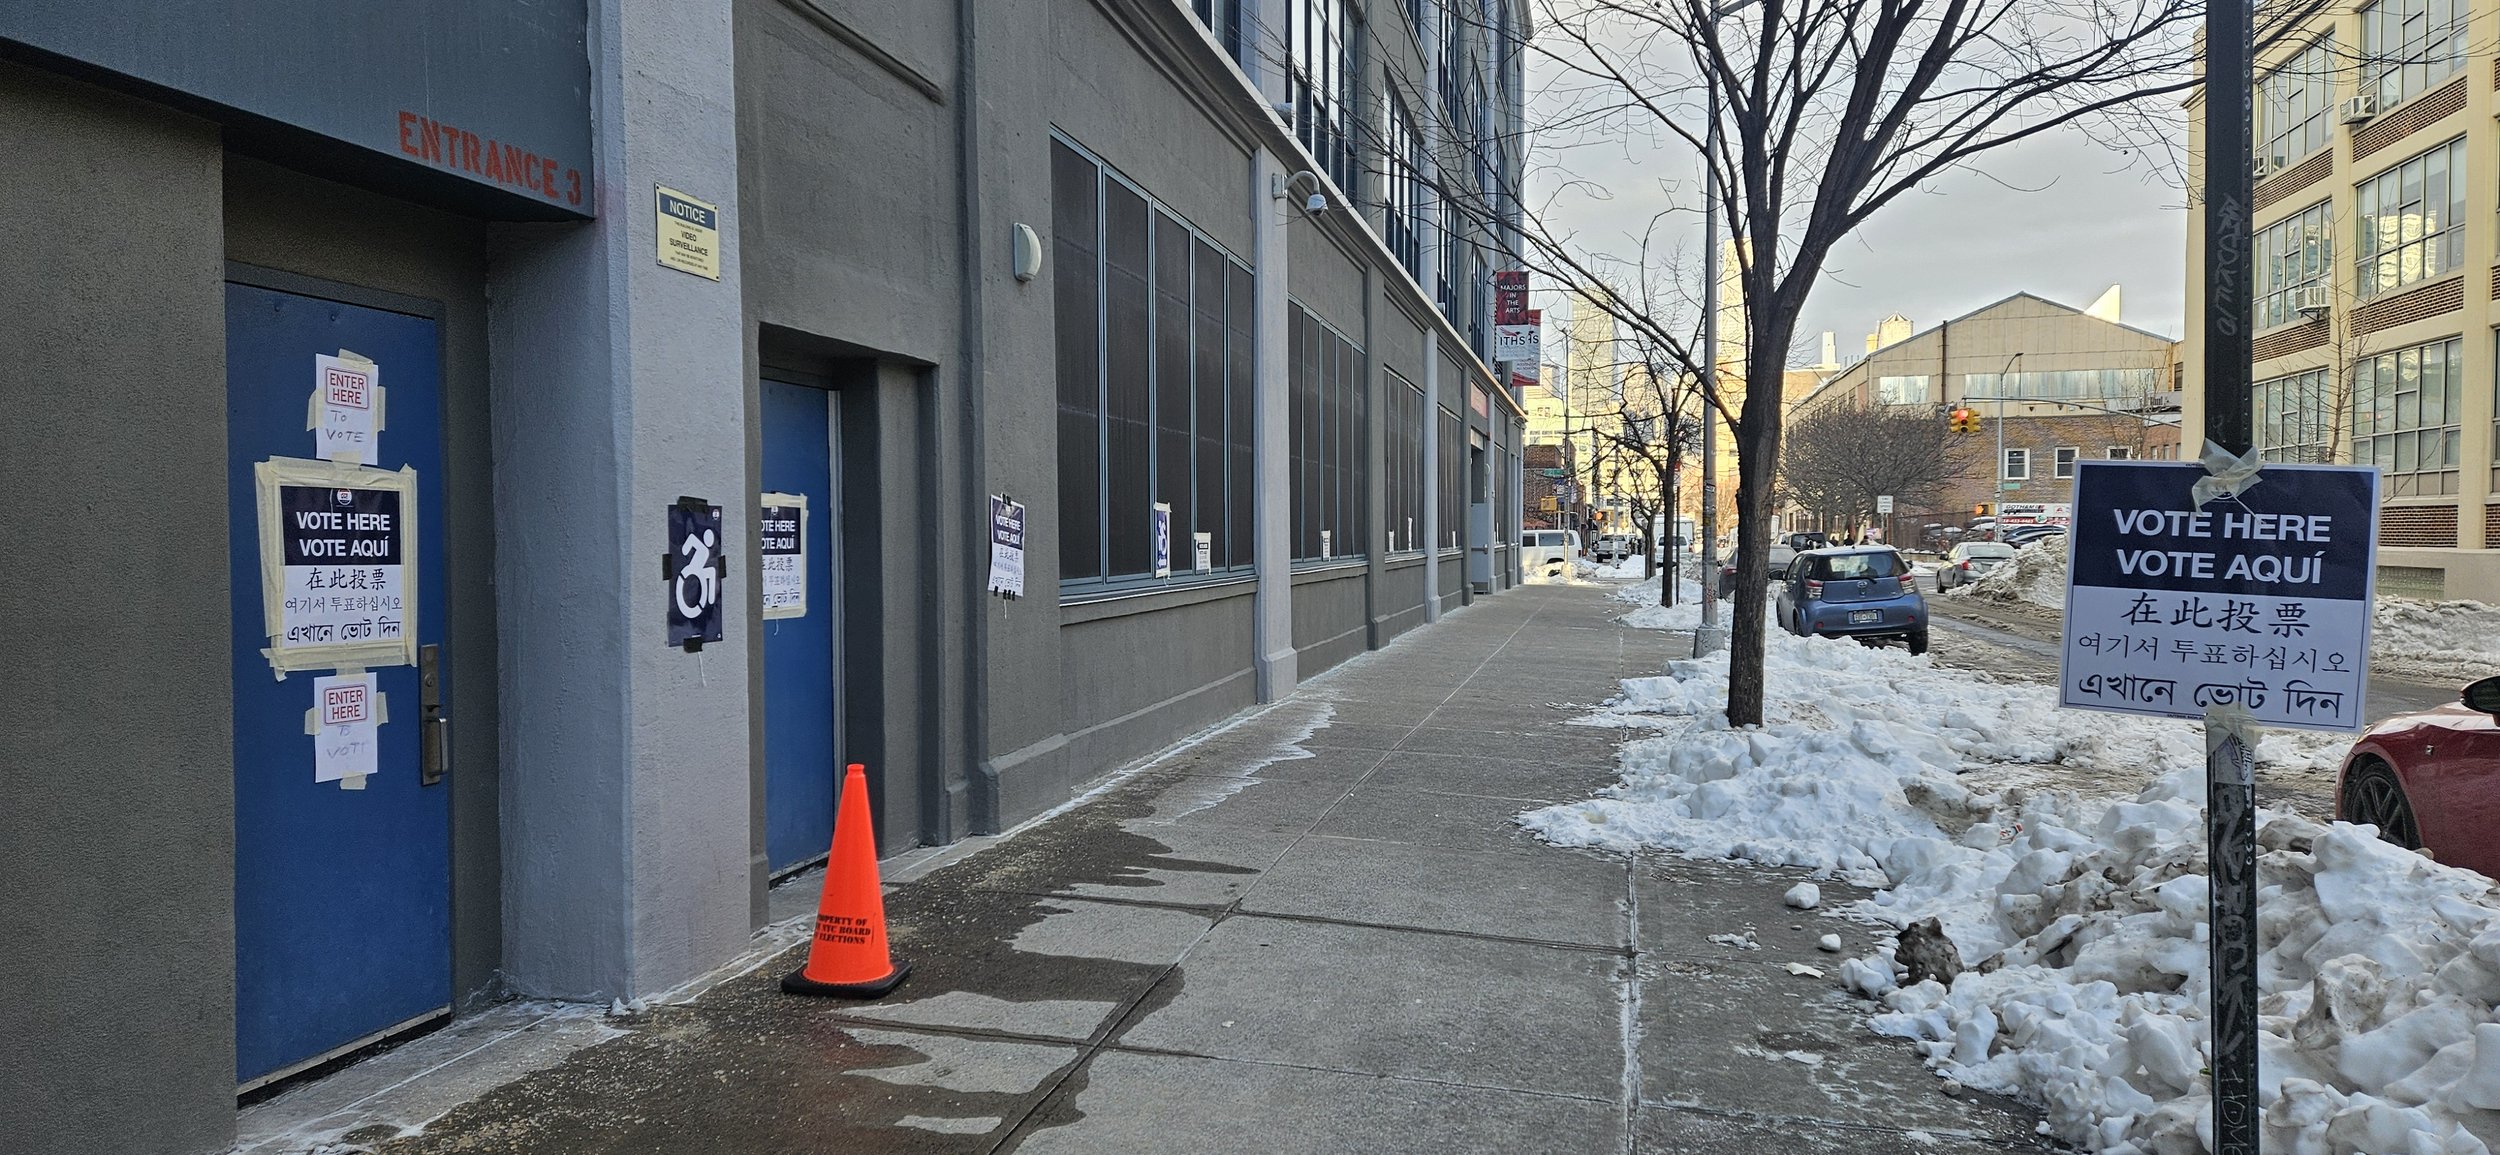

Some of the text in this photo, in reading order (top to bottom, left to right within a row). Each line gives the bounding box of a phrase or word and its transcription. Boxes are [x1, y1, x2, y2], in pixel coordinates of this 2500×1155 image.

[398, 111, 582, 207] ENTRANCE 3
[669, 200, 705, 224] NOTICE
[680, 230, 697, 242] VIDEO
[669, 238, 708, 256] SURVEILLANCE
[1500, 336, 1526, 346] ITHS
[329, 373, 365, 390] ENTER
[332, 388, 362, 405] HERE
[296, 511, 391, 531] VOTE HERE
[775, 520, 796, 532] HERE
[995, 514, 1009, 527] VOTE
[2113, 509, 2332, 542] VOTE HERE
[776, 535, 795, 549] AQUÍ
[997, 529, 1010, 542] VOTE
[299, 536, 390, 558] VOTE AQUÍ
[2116, 549, 2326, 584] VOTE AQUÍ
[305, 567, 387, 591] 在此投票
[285, 595, 403, 613] 여기서 투표하십시오
[2121, 591, 2311, 639] 在此投票
[287, 615, 401, 643] এখানে ভোট দিন
[2078, 632, 2351, 674] 여기서 투표하십시오
[328, 690, 363, 705] ENTER
[2078, 672, 2344, 719] এখানে ভোট দিন
[332, 705, 361, 720] HERE
[822, 924, 838, 933] NYC
[839, 926, 871, 936] BOARD
[856, 917, 868, 926] OF
